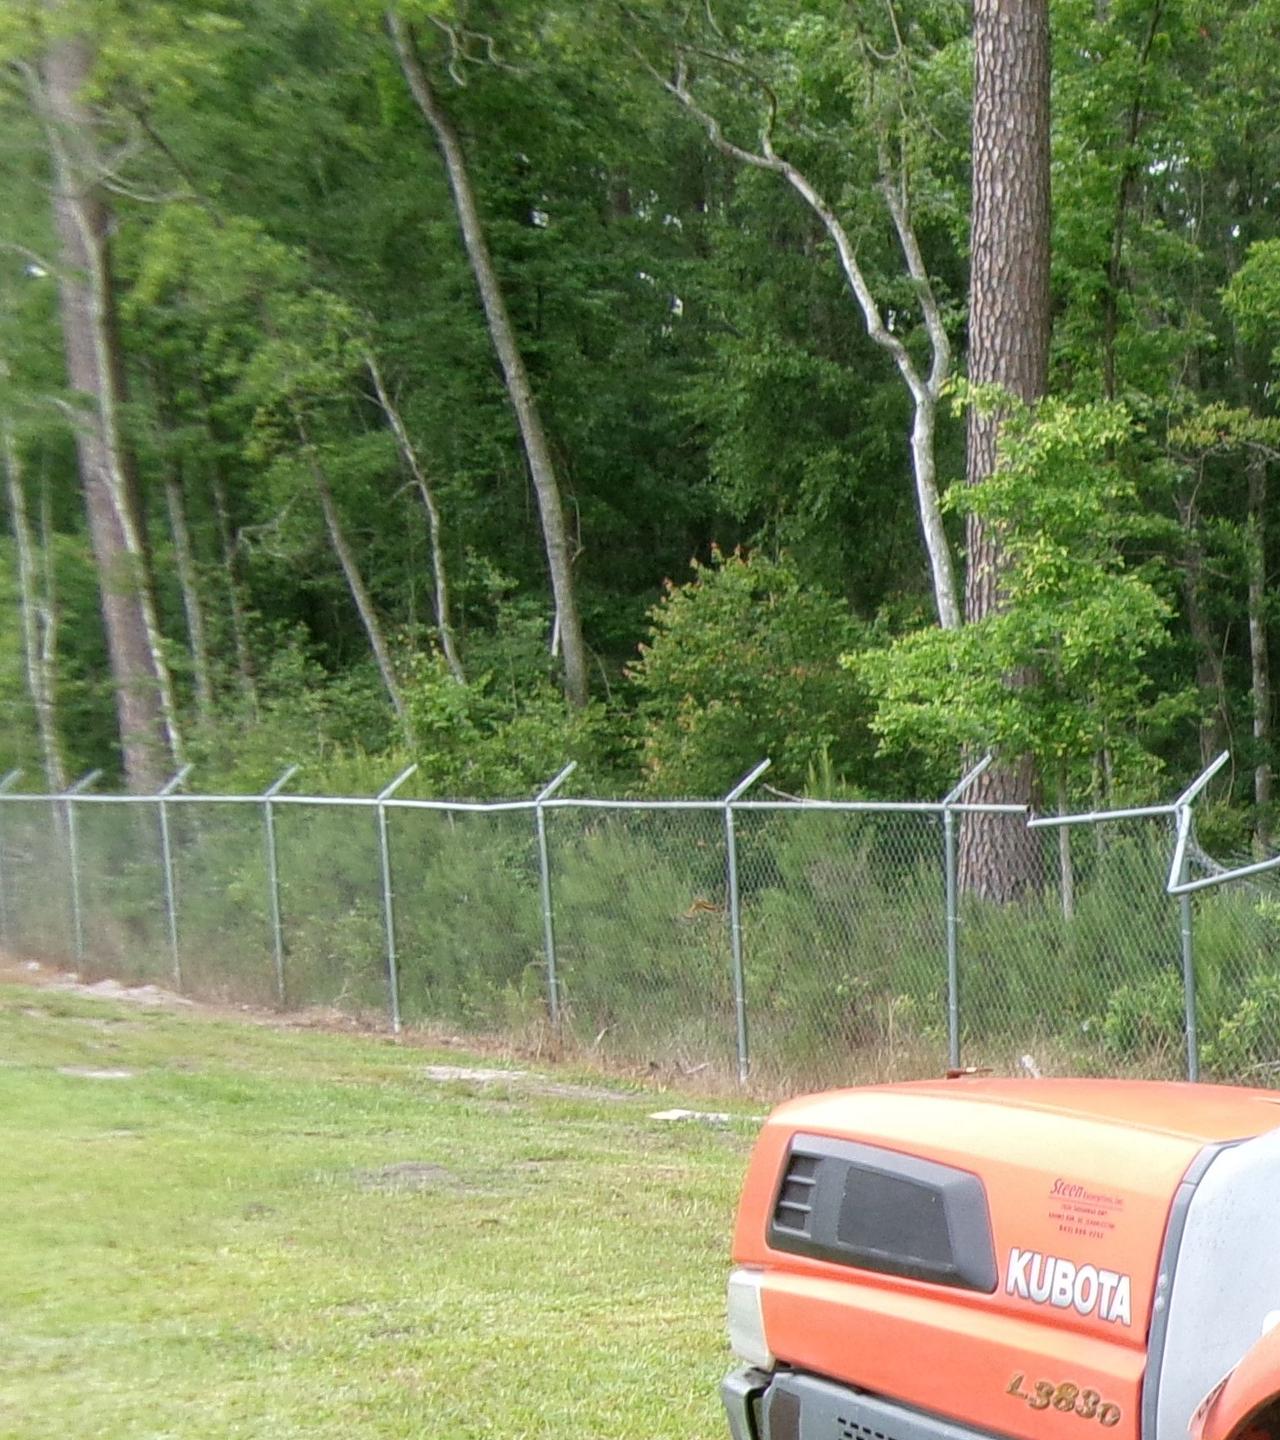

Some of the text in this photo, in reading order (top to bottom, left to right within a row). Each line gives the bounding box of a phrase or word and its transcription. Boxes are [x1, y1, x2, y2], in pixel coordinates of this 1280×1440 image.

[1049, 1178, 1084, 1198] Steen
[1005, 1247, 1132, 1327] KUBOTA
[1006, 1373, 1121, 1428] L3830
